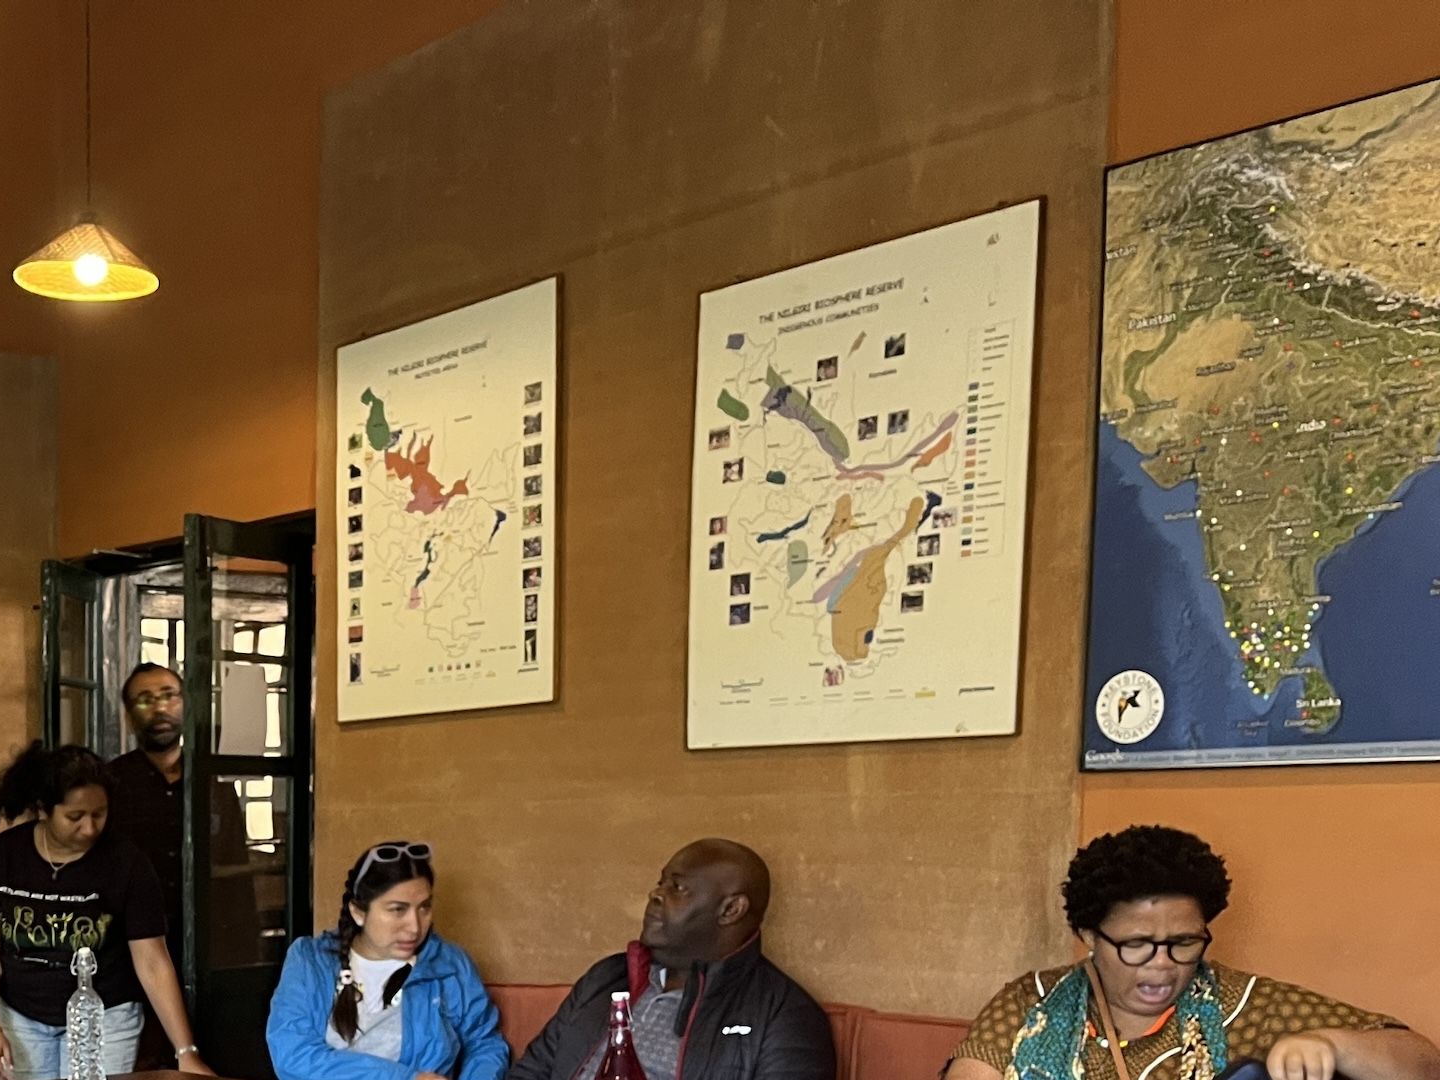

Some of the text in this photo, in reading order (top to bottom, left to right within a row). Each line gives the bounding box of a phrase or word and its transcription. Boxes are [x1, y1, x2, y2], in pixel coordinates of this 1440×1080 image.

[759, 311, 774, 324] THE
[814, 288, 862, 310] BIOSPHERE
[865, 277, 904, 297] RESERVE
[1311, 696, 1342, 709] Lanka
[1101, 708, 1159, 740] FOUNDATION
